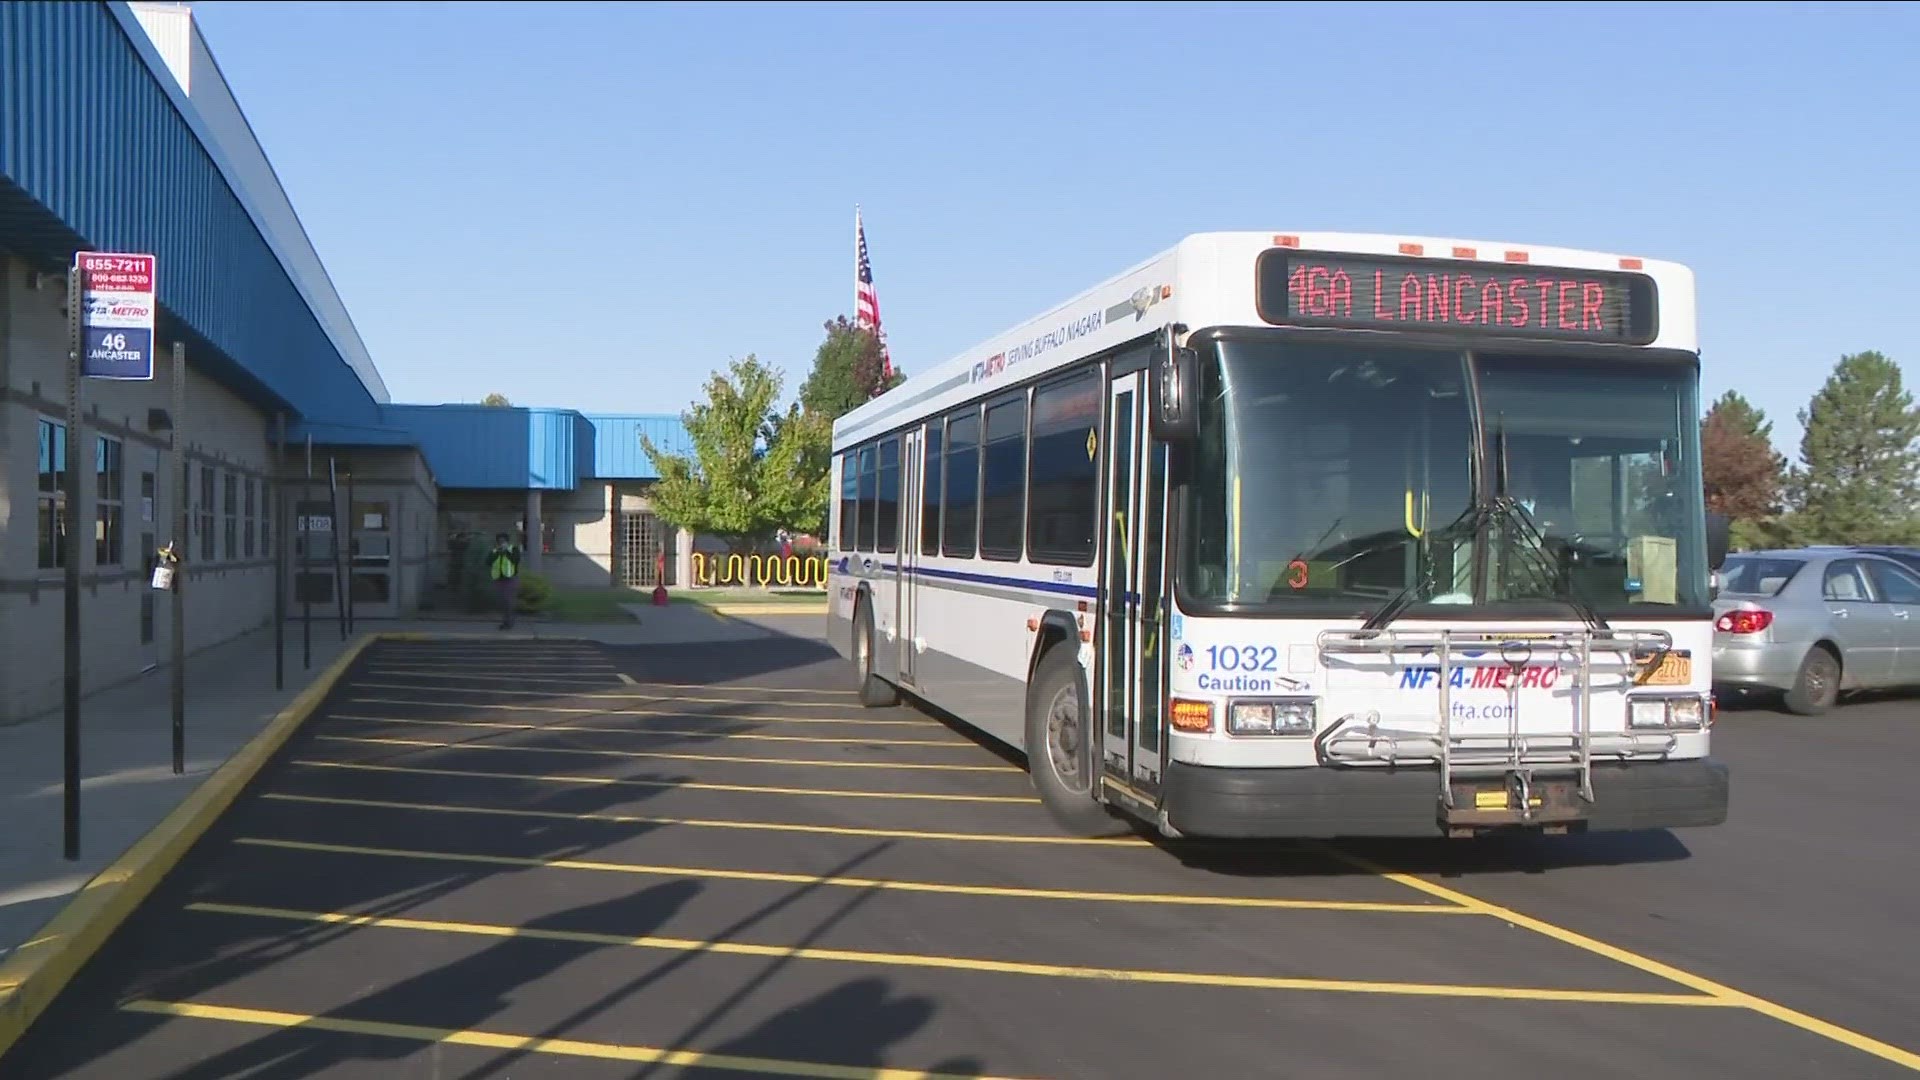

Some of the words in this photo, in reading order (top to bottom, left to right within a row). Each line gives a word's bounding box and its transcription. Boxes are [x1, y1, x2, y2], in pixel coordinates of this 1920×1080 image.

[86, 258, 146, 272] 855-7211
[1288, 264, 1352, 318] 46A
[1374, 269, 1605, 331] LANCASTER
[101, 332, 126, 351] 46
[1034, 327, 1066, 357] BUFFALO
[1065, 309, 1102, 343] NIAGARA
[87, 349, 141, 360] LANCASTER
[1288, 560, 1308, 588] 3
[1206, 644, 1278, 672] 1032
[1198, 673, 1272, 691] Caution
